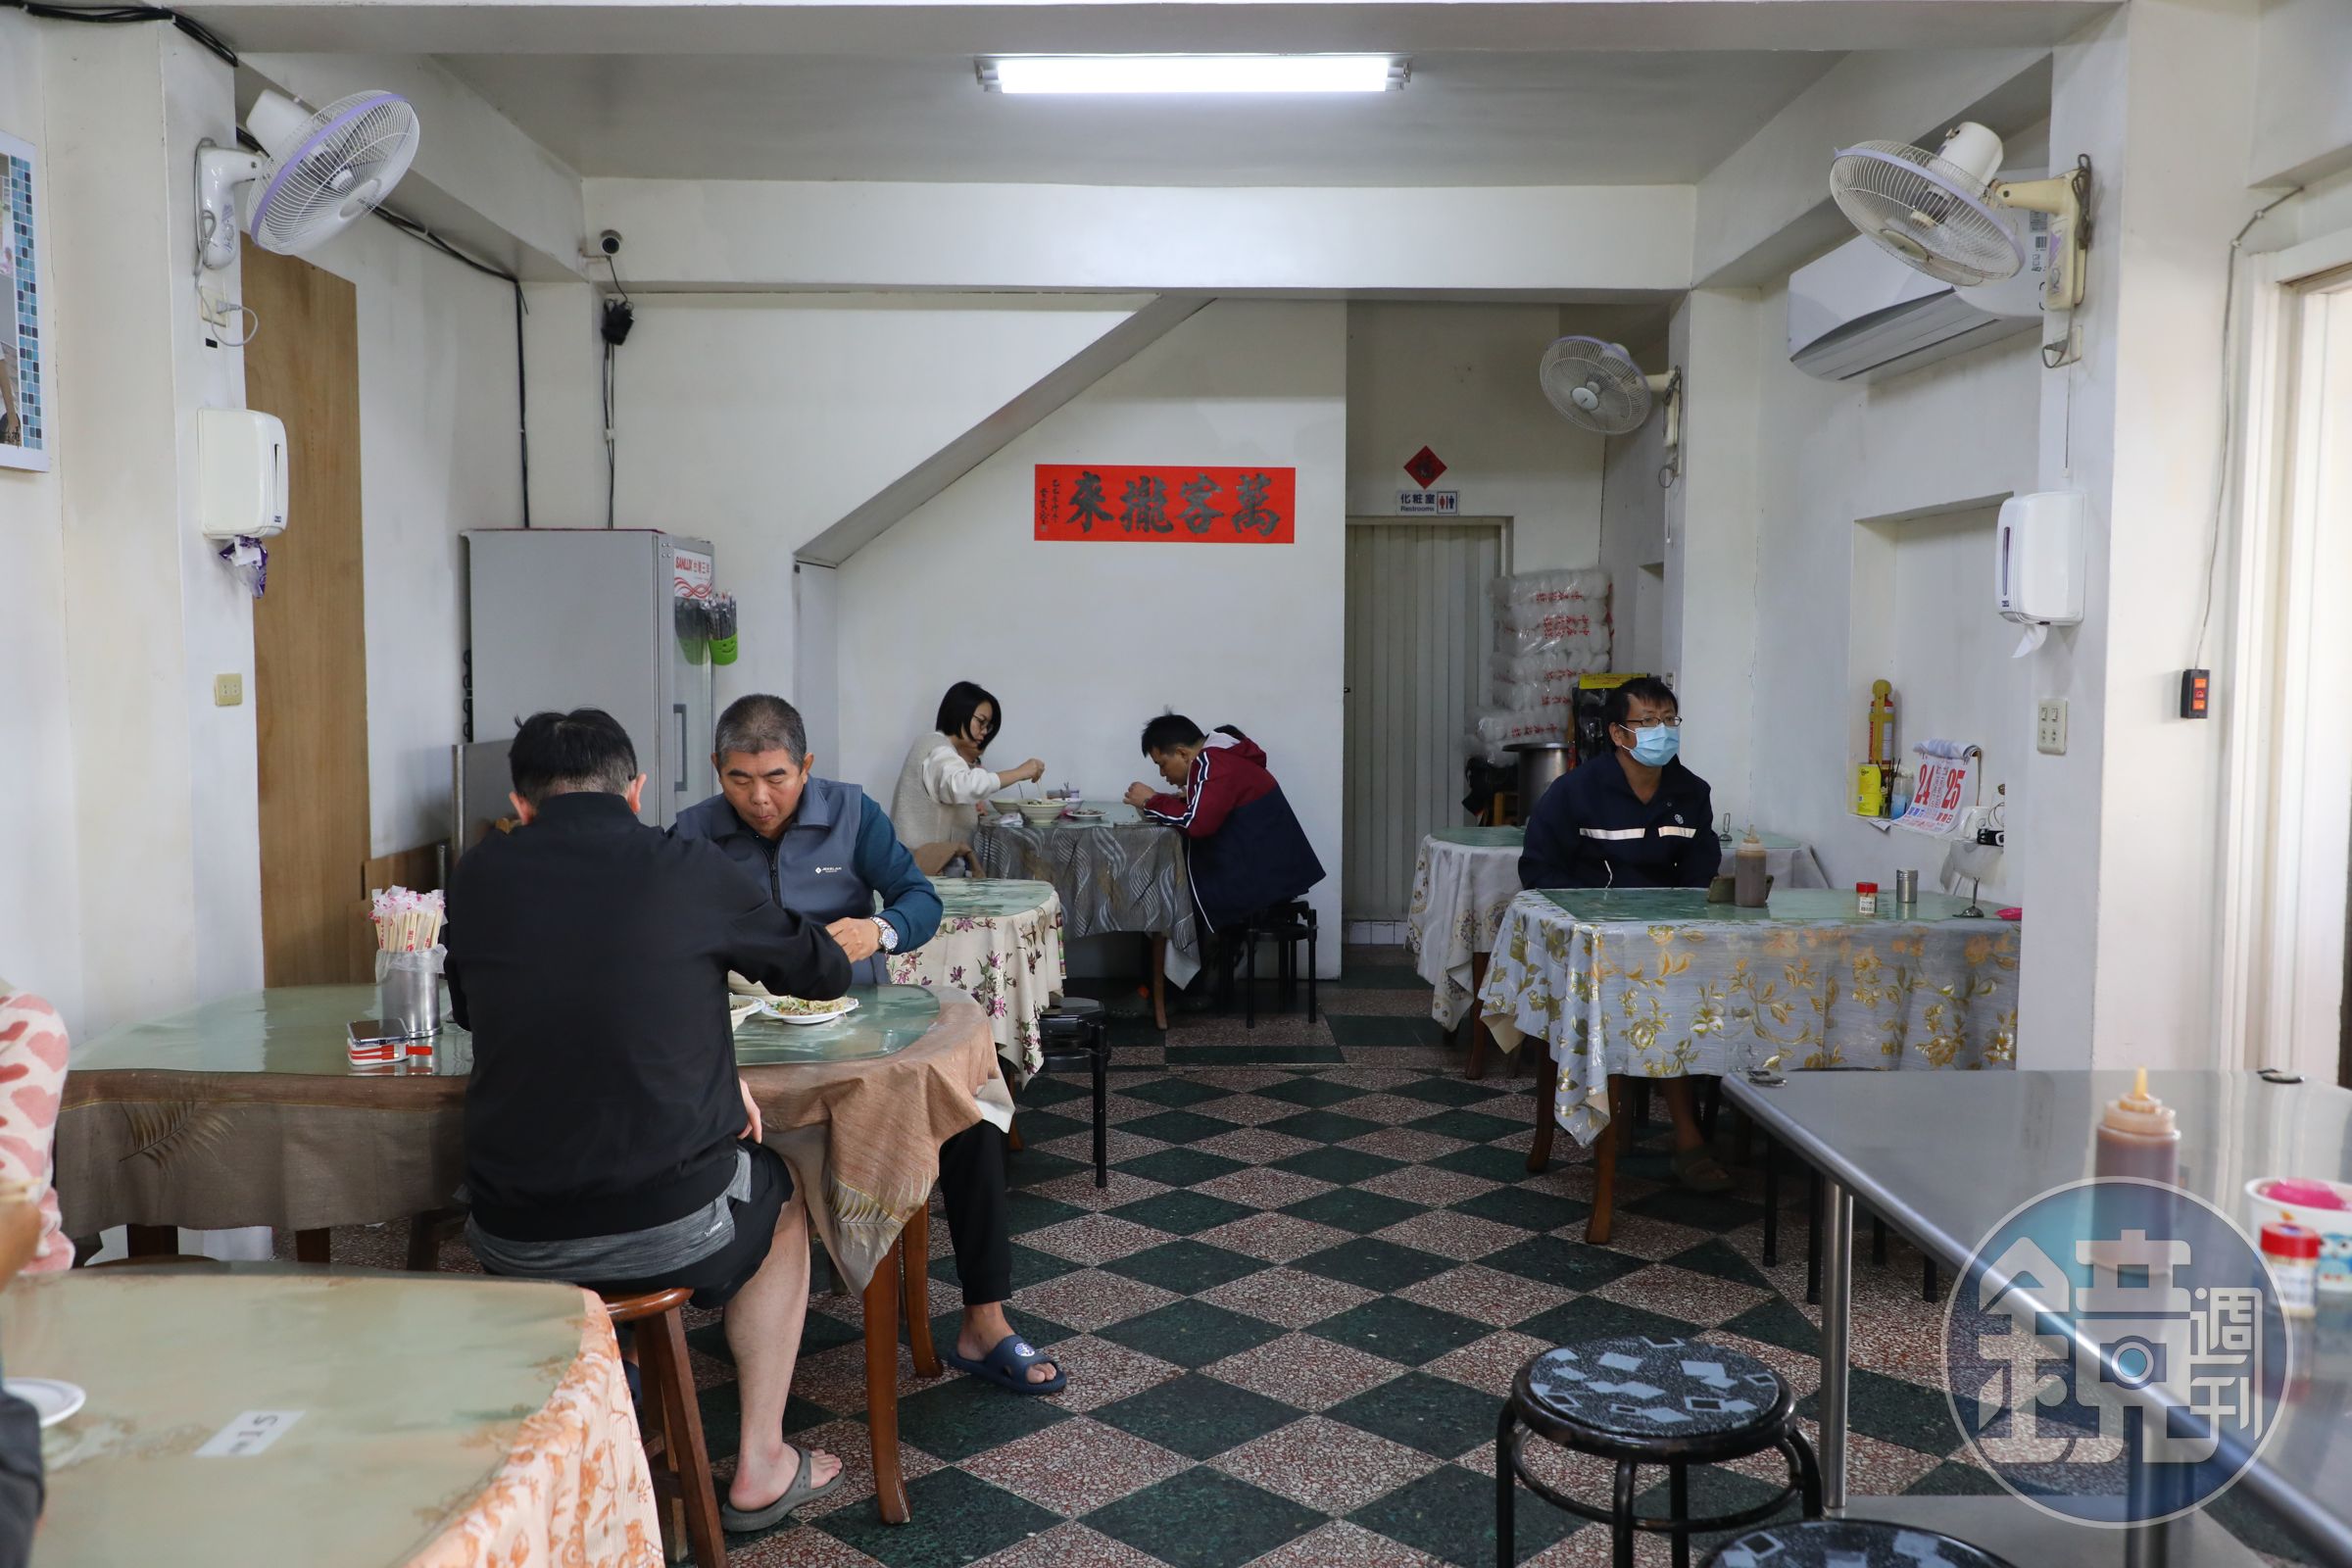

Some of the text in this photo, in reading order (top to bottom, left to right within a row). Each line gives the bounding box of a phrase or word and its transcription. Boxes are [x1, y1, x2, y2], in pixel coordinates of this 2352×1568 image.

[1400, 493, 1435, 505] 化粧室
[1914, 763, 1936, 806] 24
[1940, 767, 1966, 810] 25
